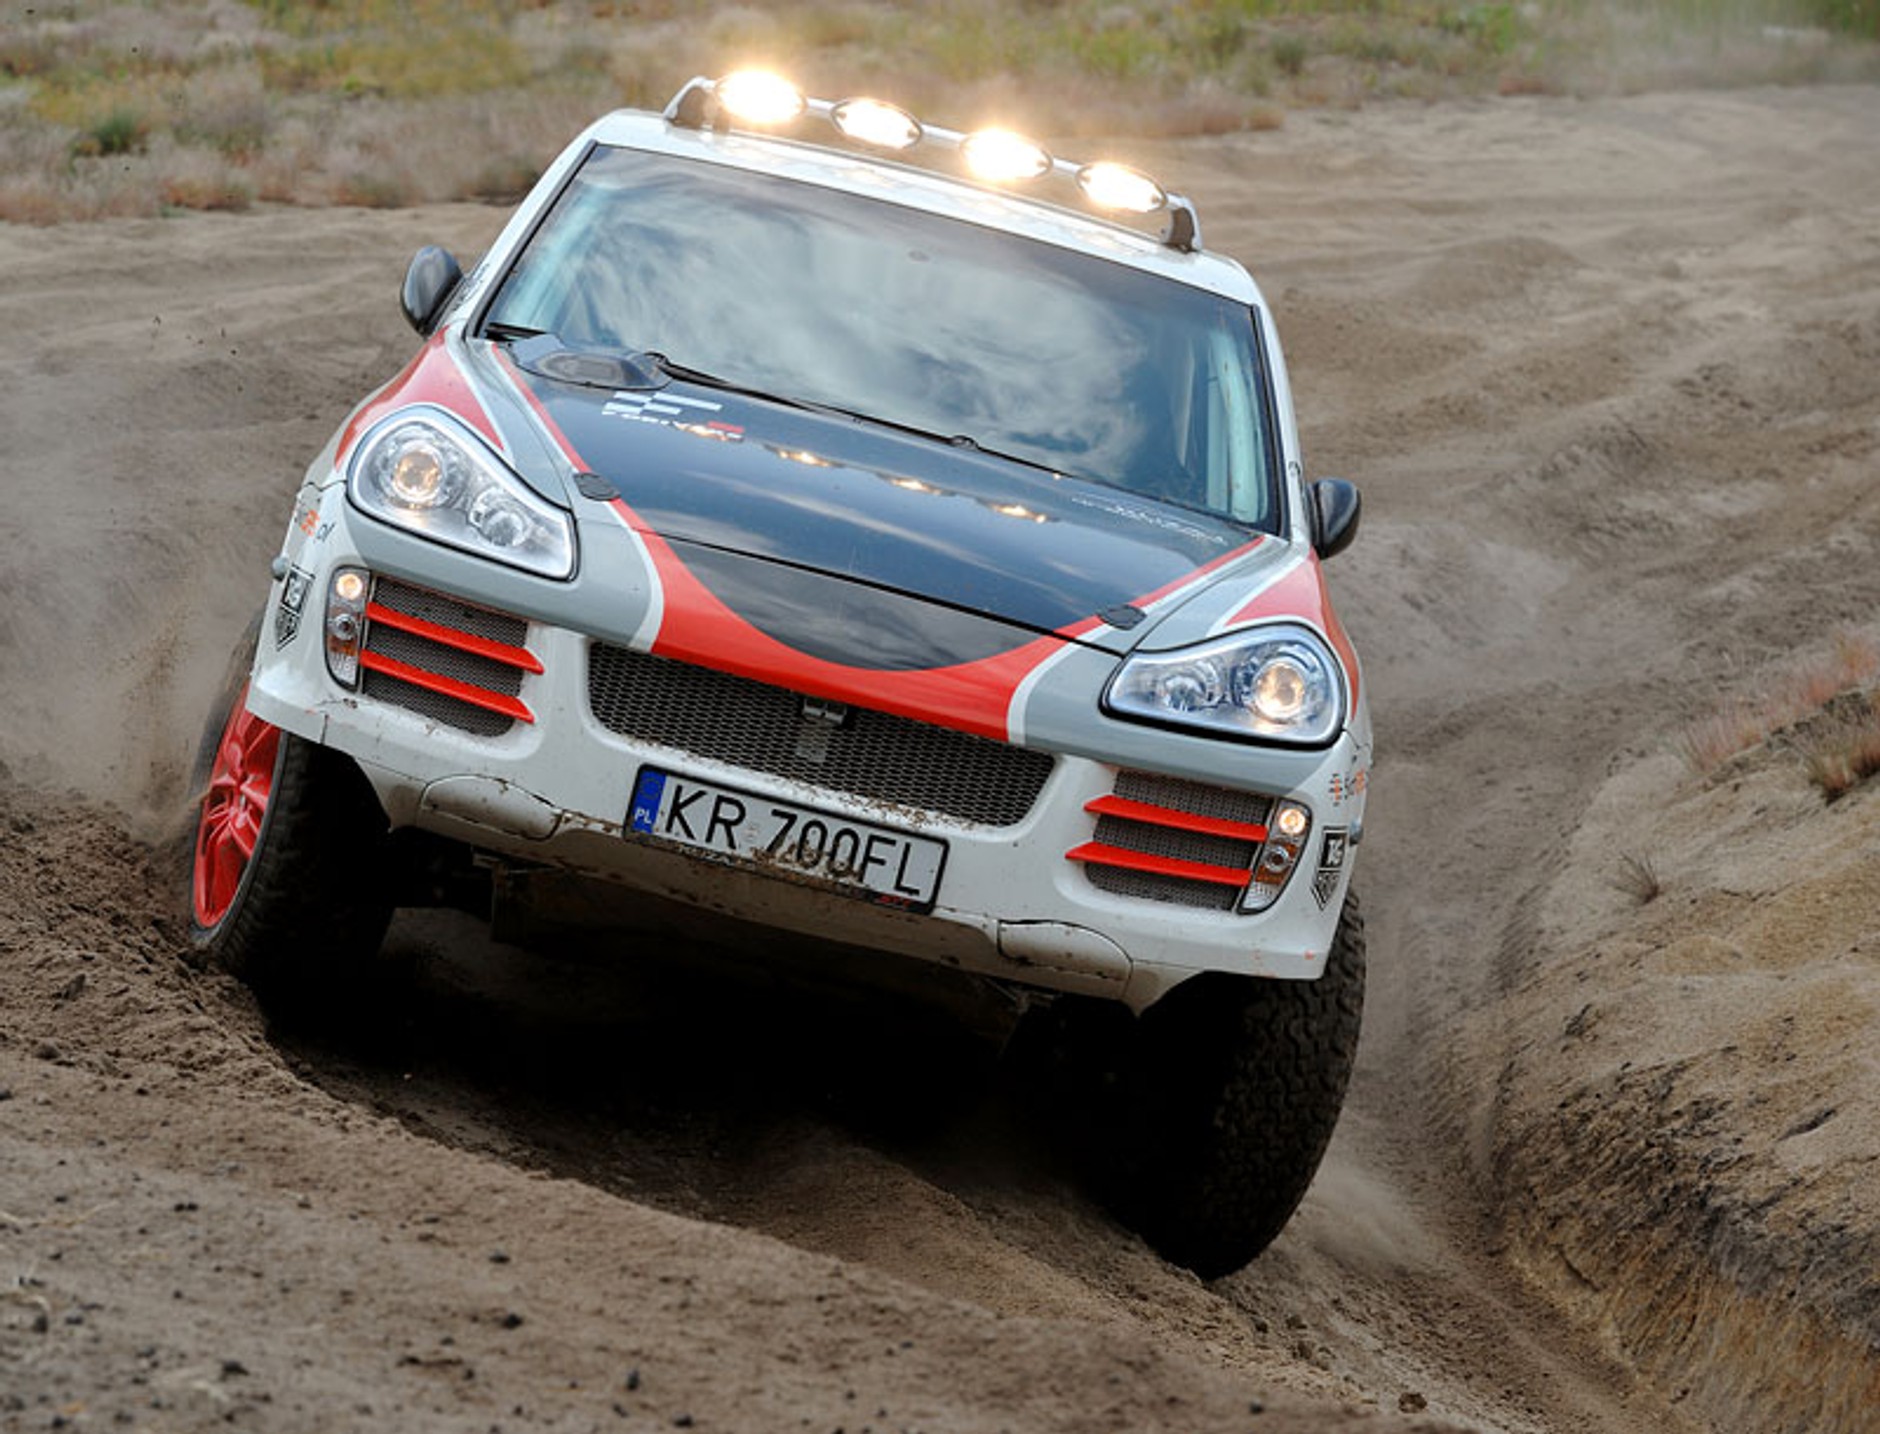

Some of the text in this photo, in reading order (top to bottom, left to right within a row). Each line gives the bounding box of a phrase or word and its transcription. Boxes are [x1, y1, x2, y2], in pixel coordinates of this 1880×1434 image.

[634, 807, 652, 825] PL
[665, 784, 920, 895] KR 700FL
